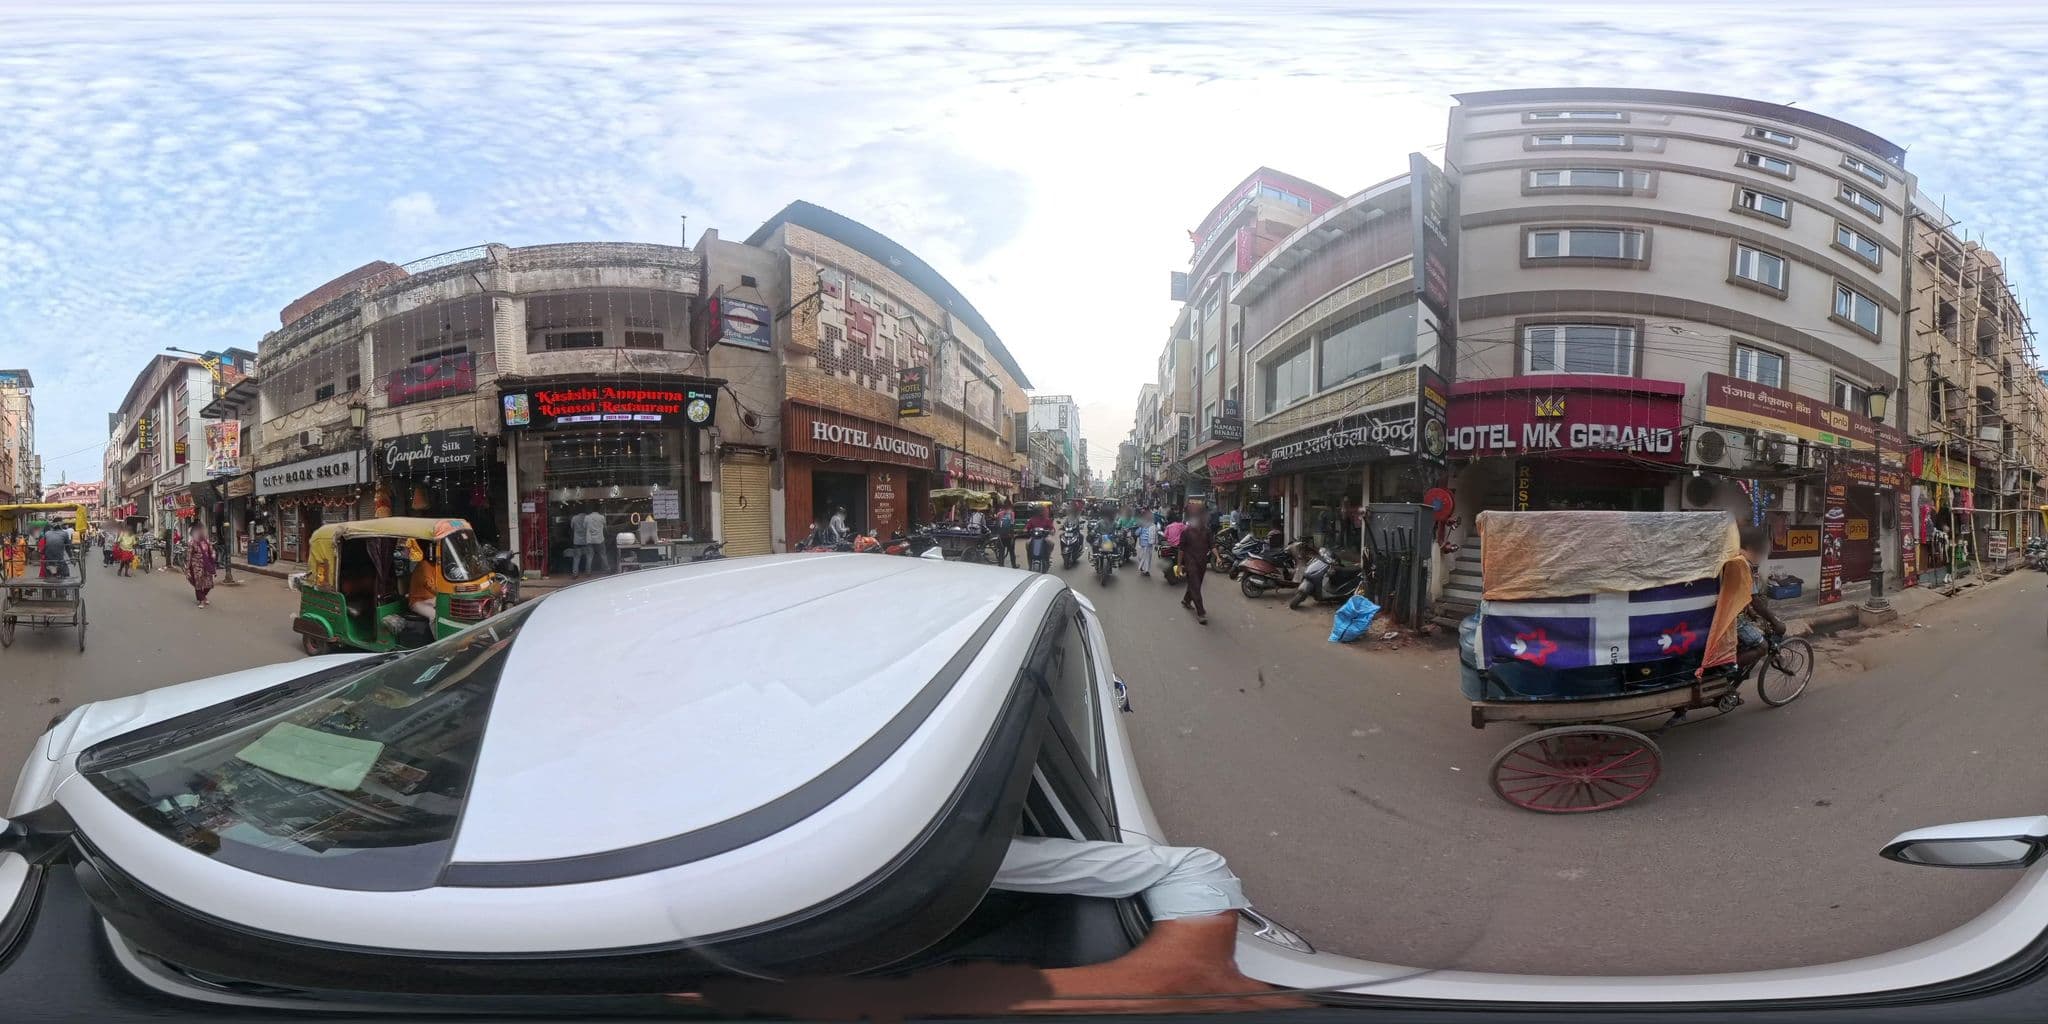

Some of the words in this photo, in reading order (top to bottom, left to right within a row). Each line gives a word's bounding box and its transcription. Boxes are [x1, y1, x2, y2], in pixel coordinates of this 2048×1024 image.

[139, 418, 147, 449] HOTEL
[1833, 416, 1848, 428] pnb
[442, 441, 461, 451] Silk
[812, 421, 871, 448] HOTEL
[873, 434, 929, 460] AUGUSTO
[1446, 424, 1516, 451] HOTEL
[1522, 423, 1562, 448] MK
[386, 445, 432, 470] Ganpati
[433, 453, 470, 464] Factory
[262, 472, 283, 488] CITY
[317, 461, 350, 479] SHOP
[876, 484, 891, 492] HOTEL
[1519, 465, 1530, 511] REST
[1791, 533, 1813, 547] pnb
